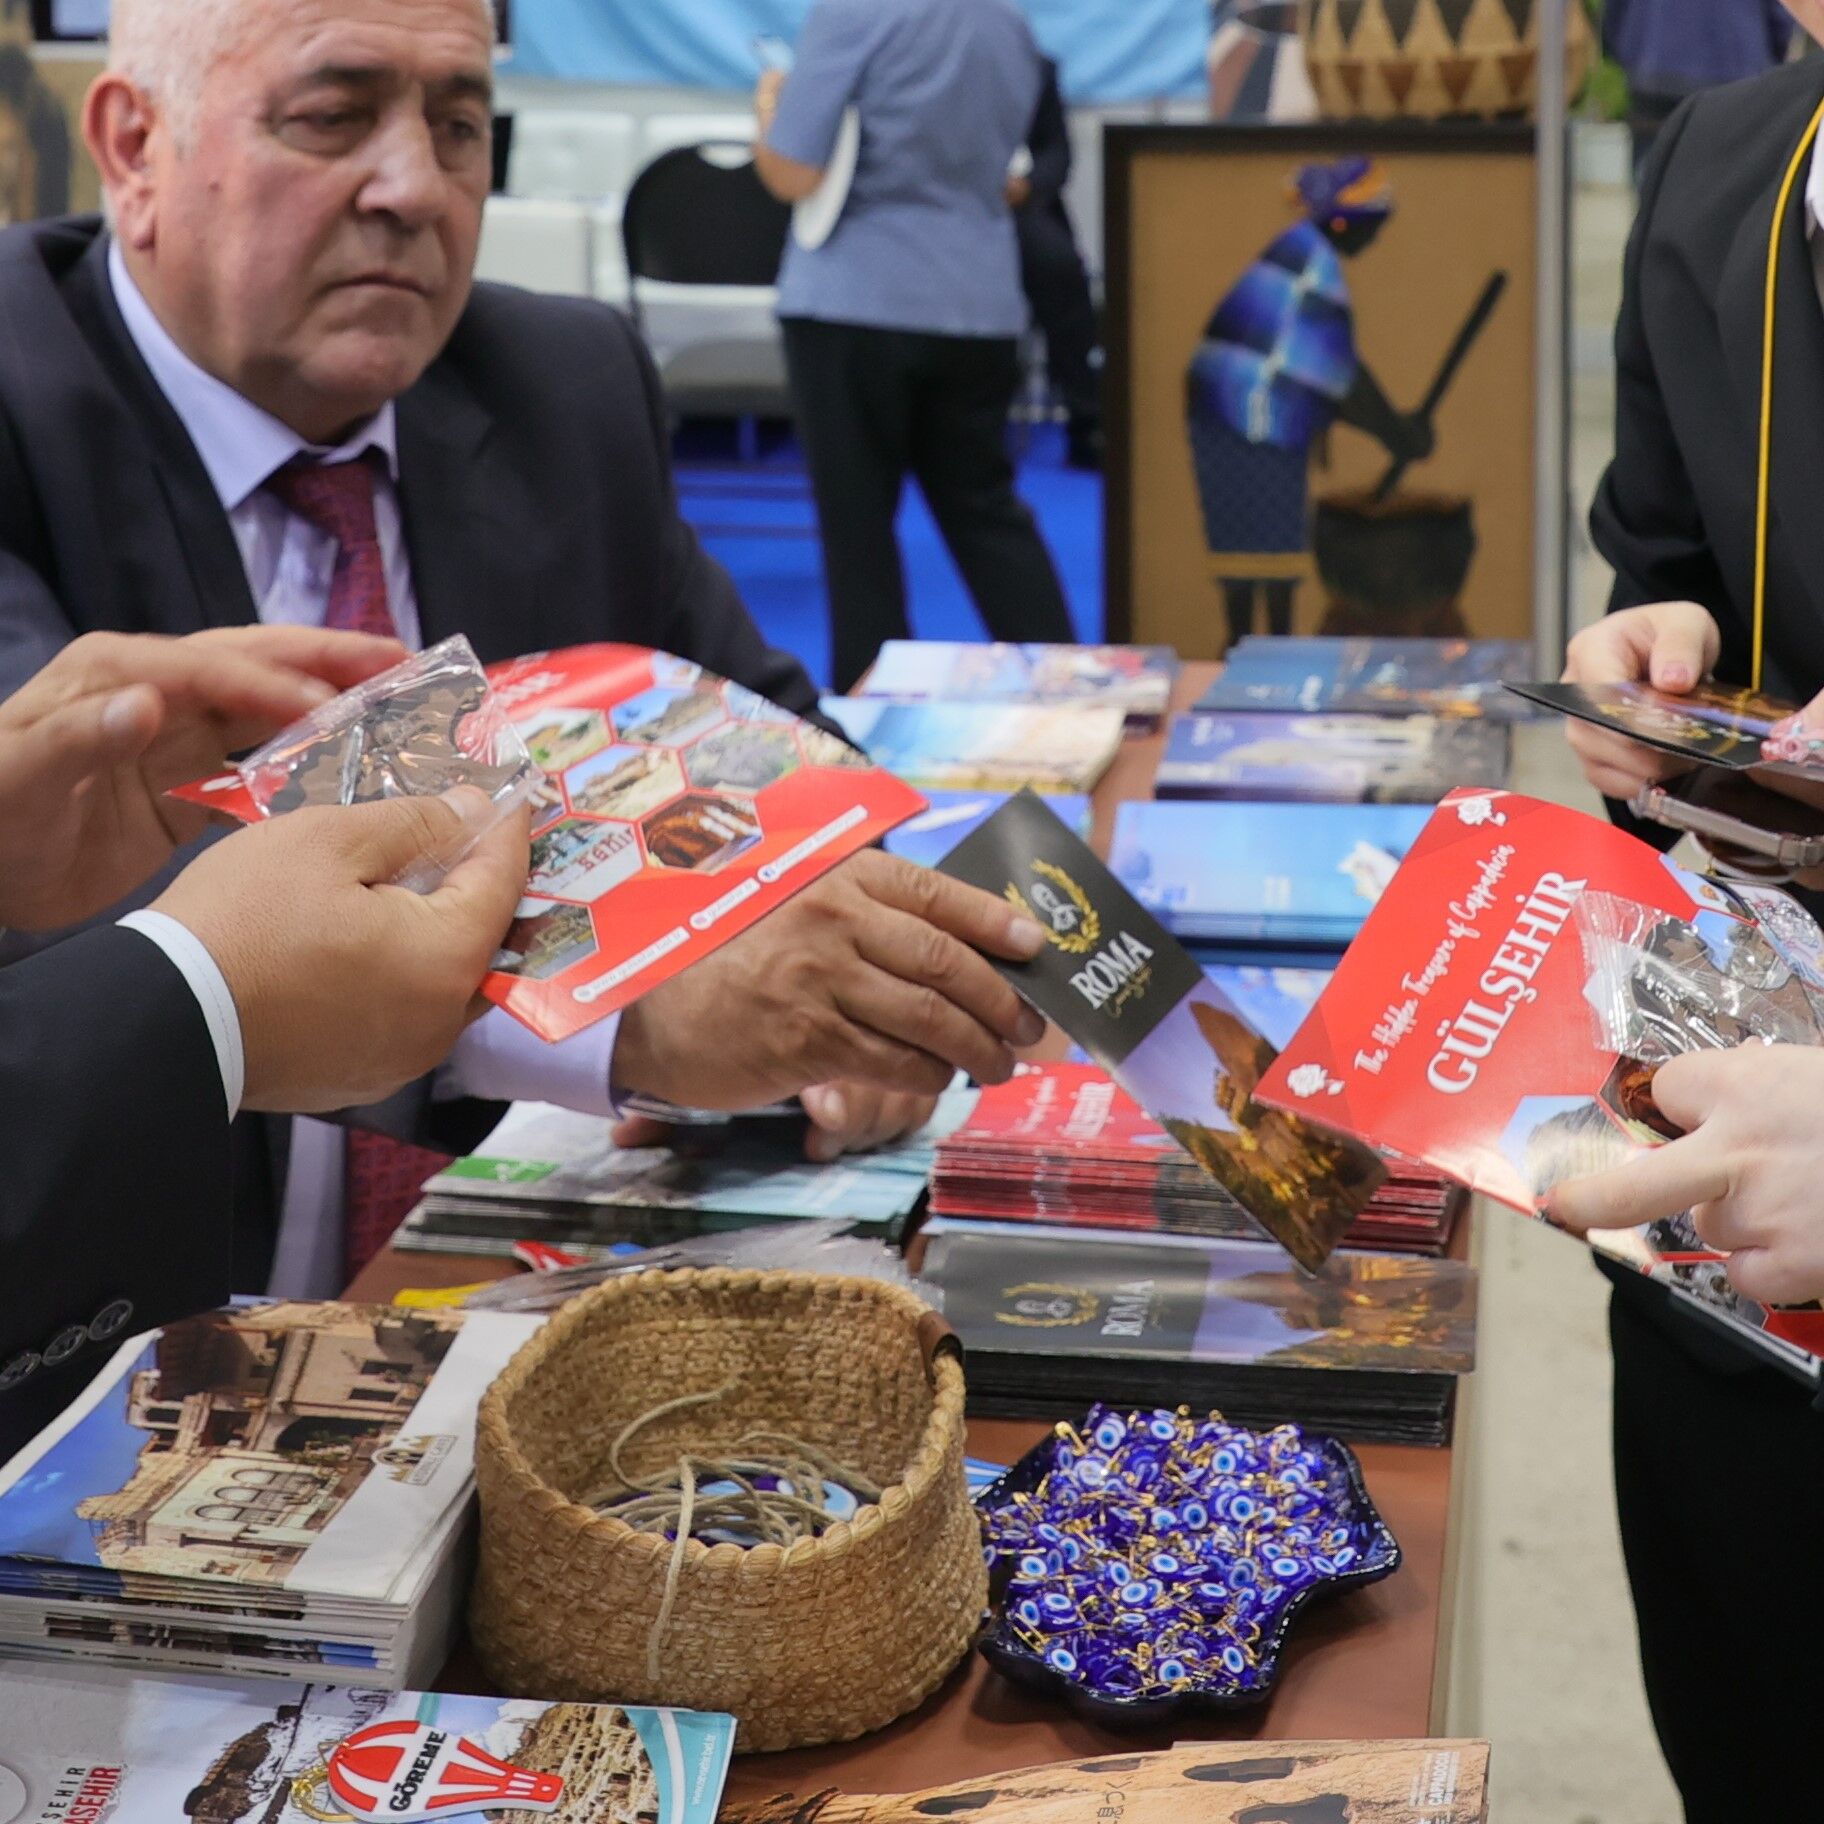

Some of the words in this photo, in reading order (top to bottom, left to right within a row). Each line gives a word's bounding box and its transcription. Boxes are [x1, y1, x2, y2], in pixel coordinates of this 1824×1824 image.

[1068, 930, 1155, 1009] ROMA
[1427, 871, 1588, 1094] GÜLŞEHİR
[1100, 1280, 1155, 1337] ROMA
[389, 1731, 447, 1812] GÖREME
[1427, 1750, 1453, 1805] CAPPADOCIA
